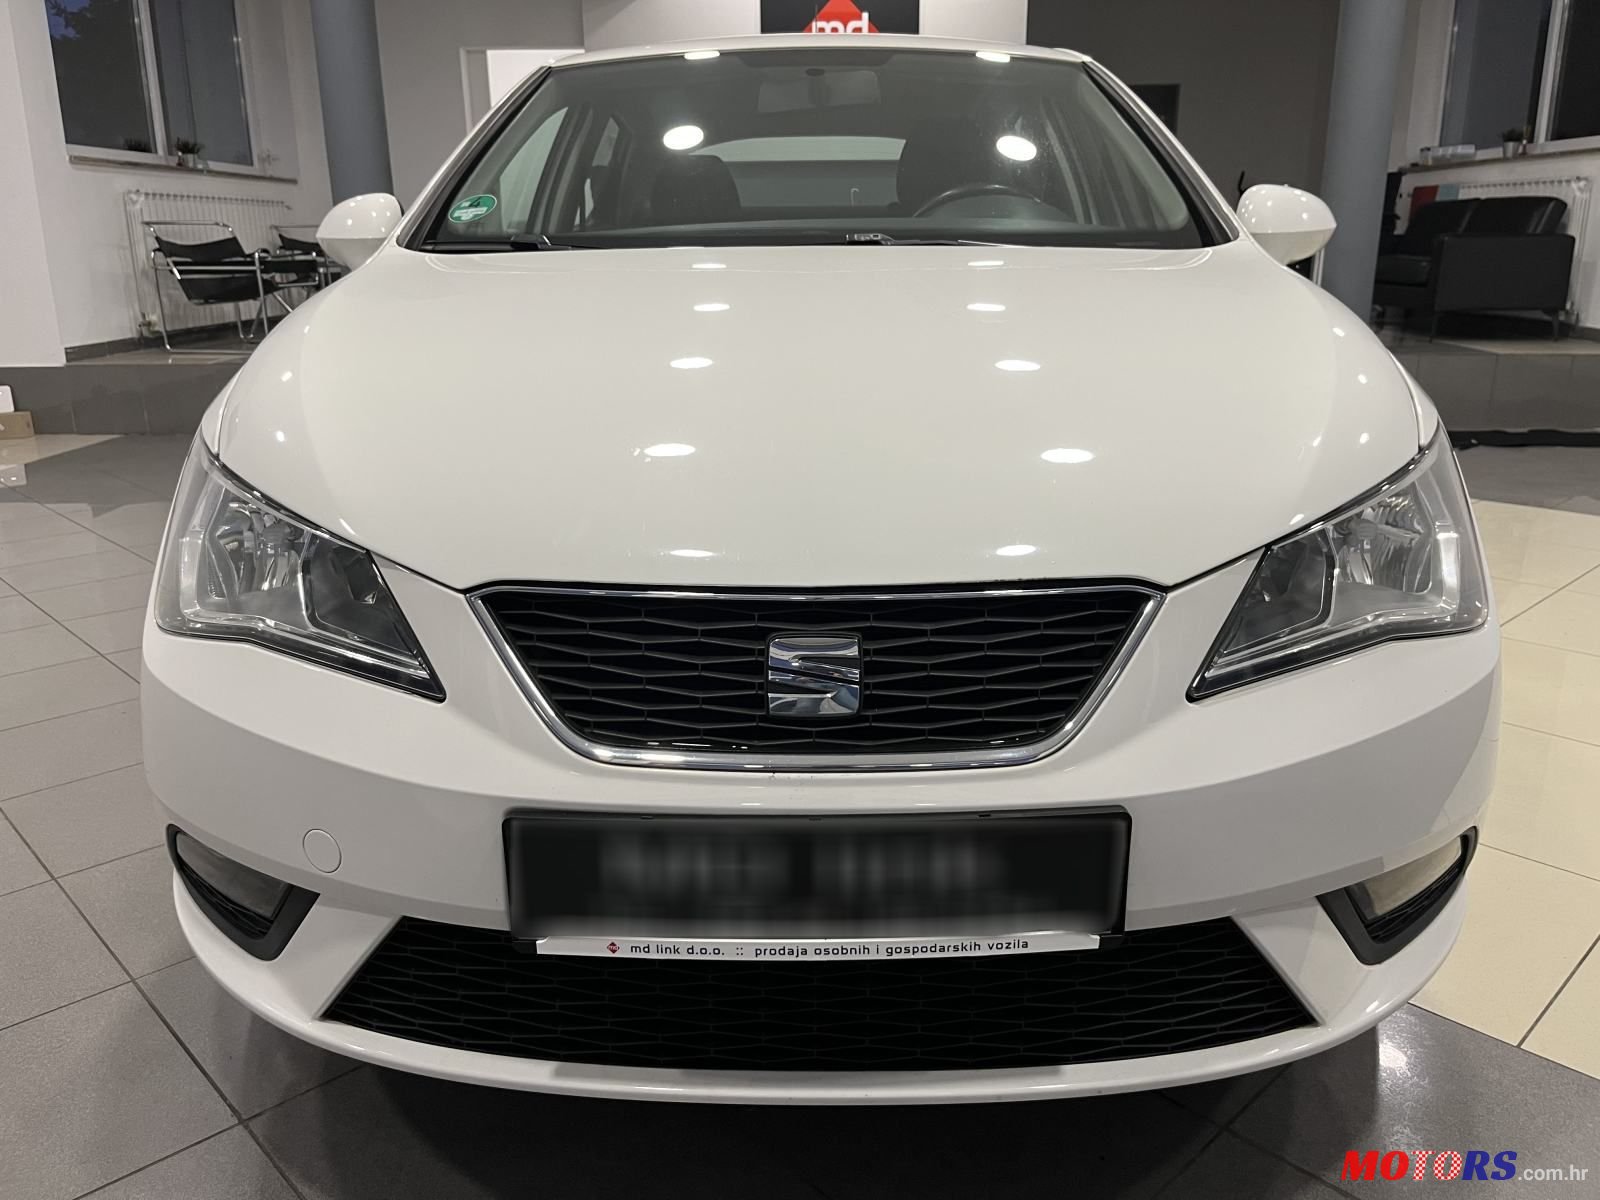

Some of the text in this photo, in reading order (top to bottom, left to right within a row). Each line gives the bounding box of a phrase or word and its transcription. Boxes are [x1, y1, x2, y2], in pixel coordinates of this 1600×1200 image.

[630, 943, 651, 954] md
[656, 944, 681, 955] link
[686, 944, 725, 956] d.o.o.
[754, 945, 808, 958] prodaja
[813, 944, 870, 956] osobnih
[885, 941, 981, 957] gospodarskih
[987, 939, 1029, 951] vozila
